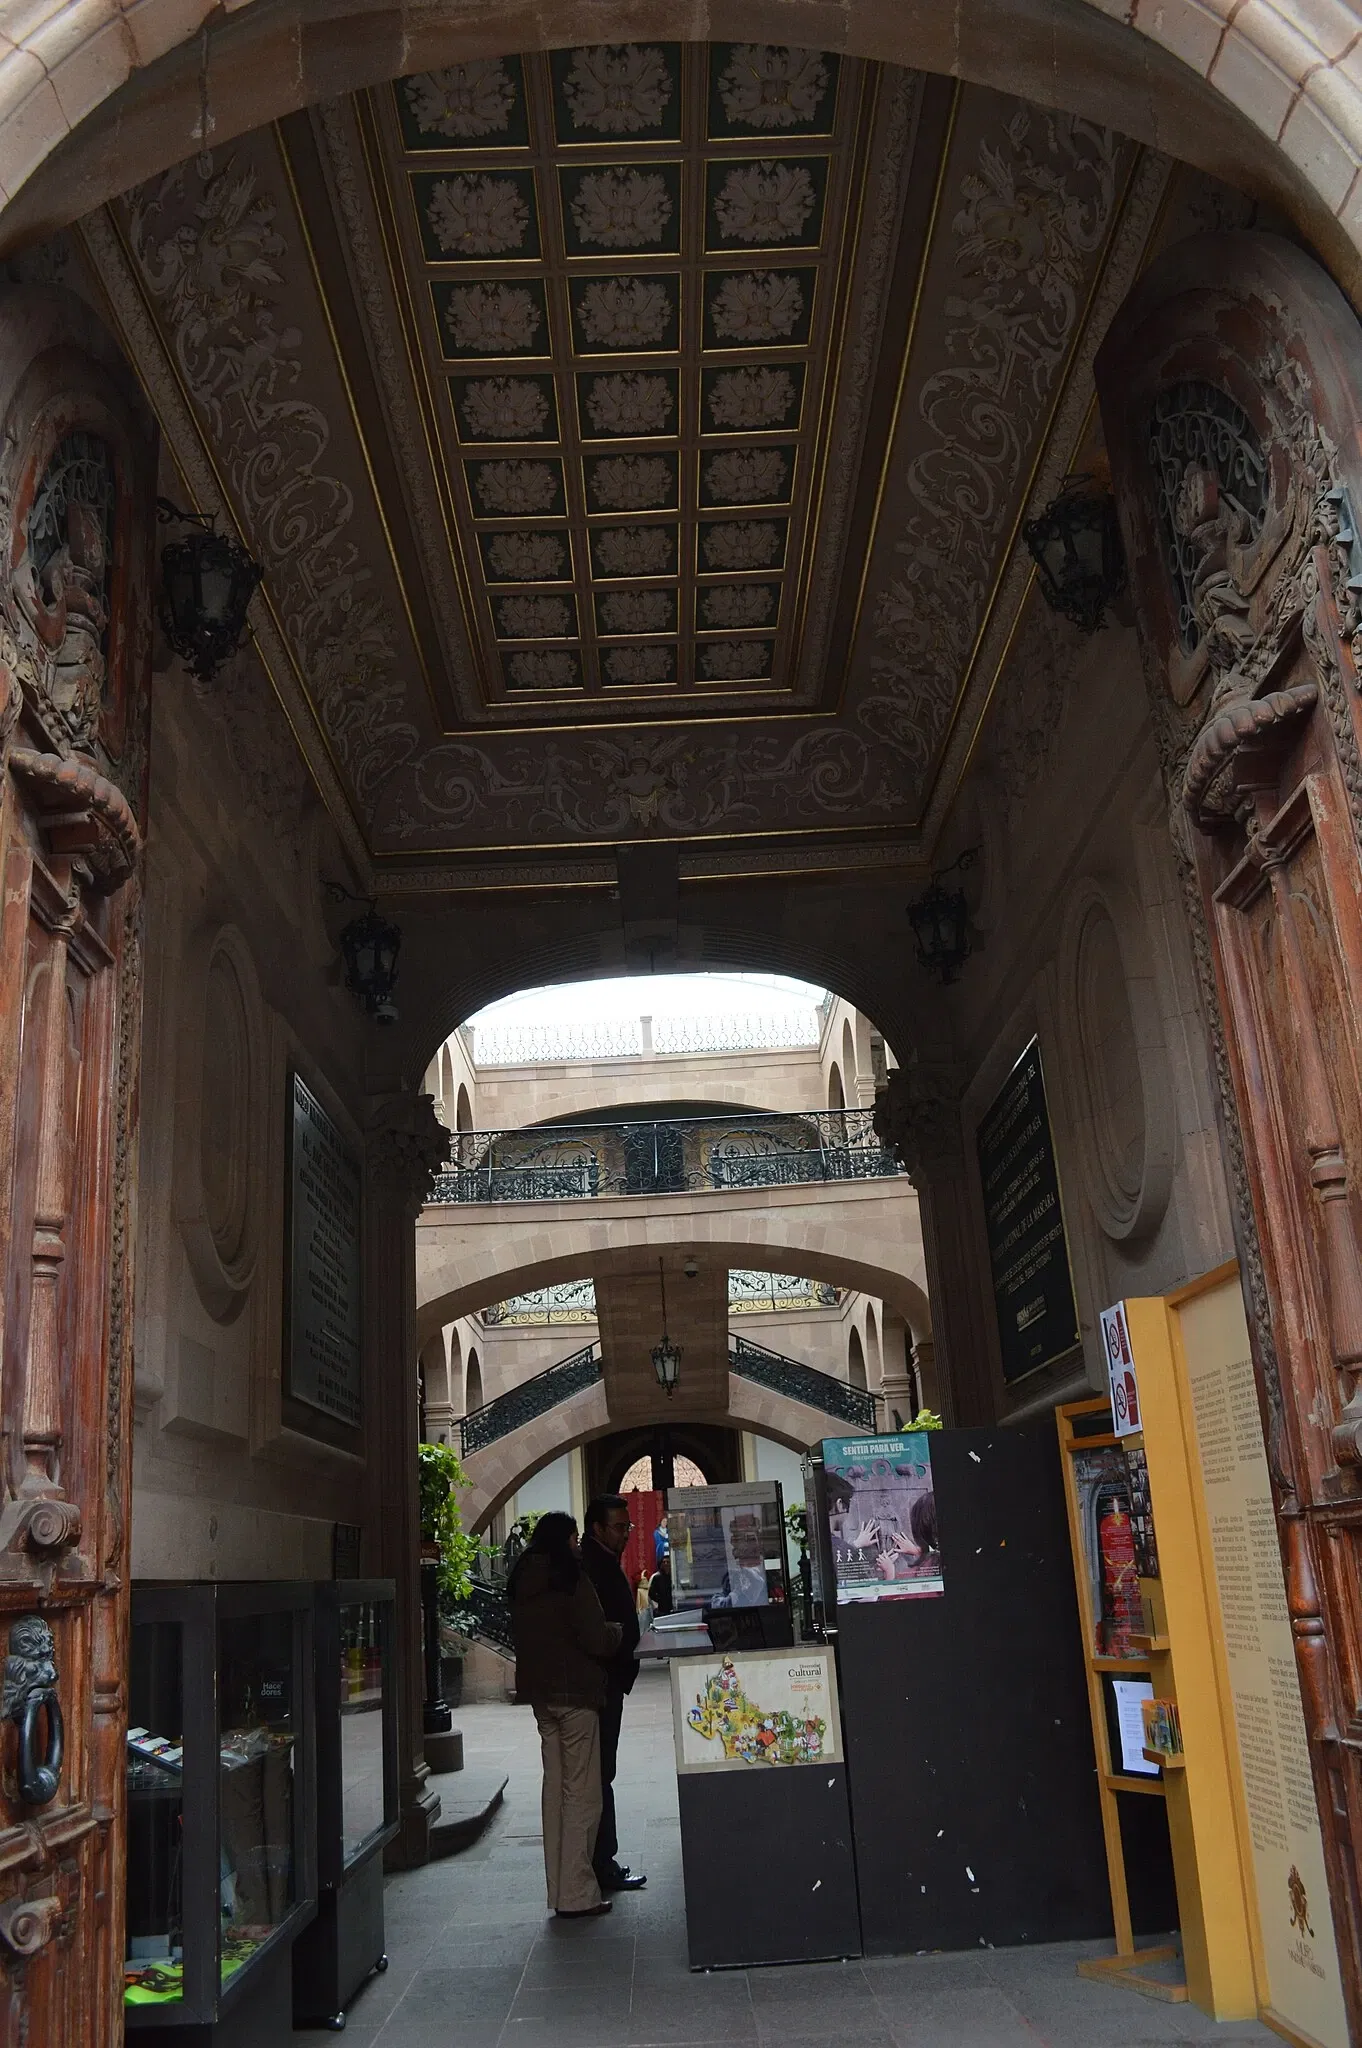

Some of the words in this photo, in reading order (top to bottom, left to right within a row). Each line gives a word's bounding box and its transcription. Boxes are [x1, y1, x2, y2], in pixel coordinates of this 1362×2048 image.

[842, 1446, 869, 1456] SENTIR
[869, 1444, 889, 1454] PARA
[788, 1667, 821, 1677] Cultural
[263, 1682, 281, 1690] Hace
[261, 1687, 281, 1696] dores
